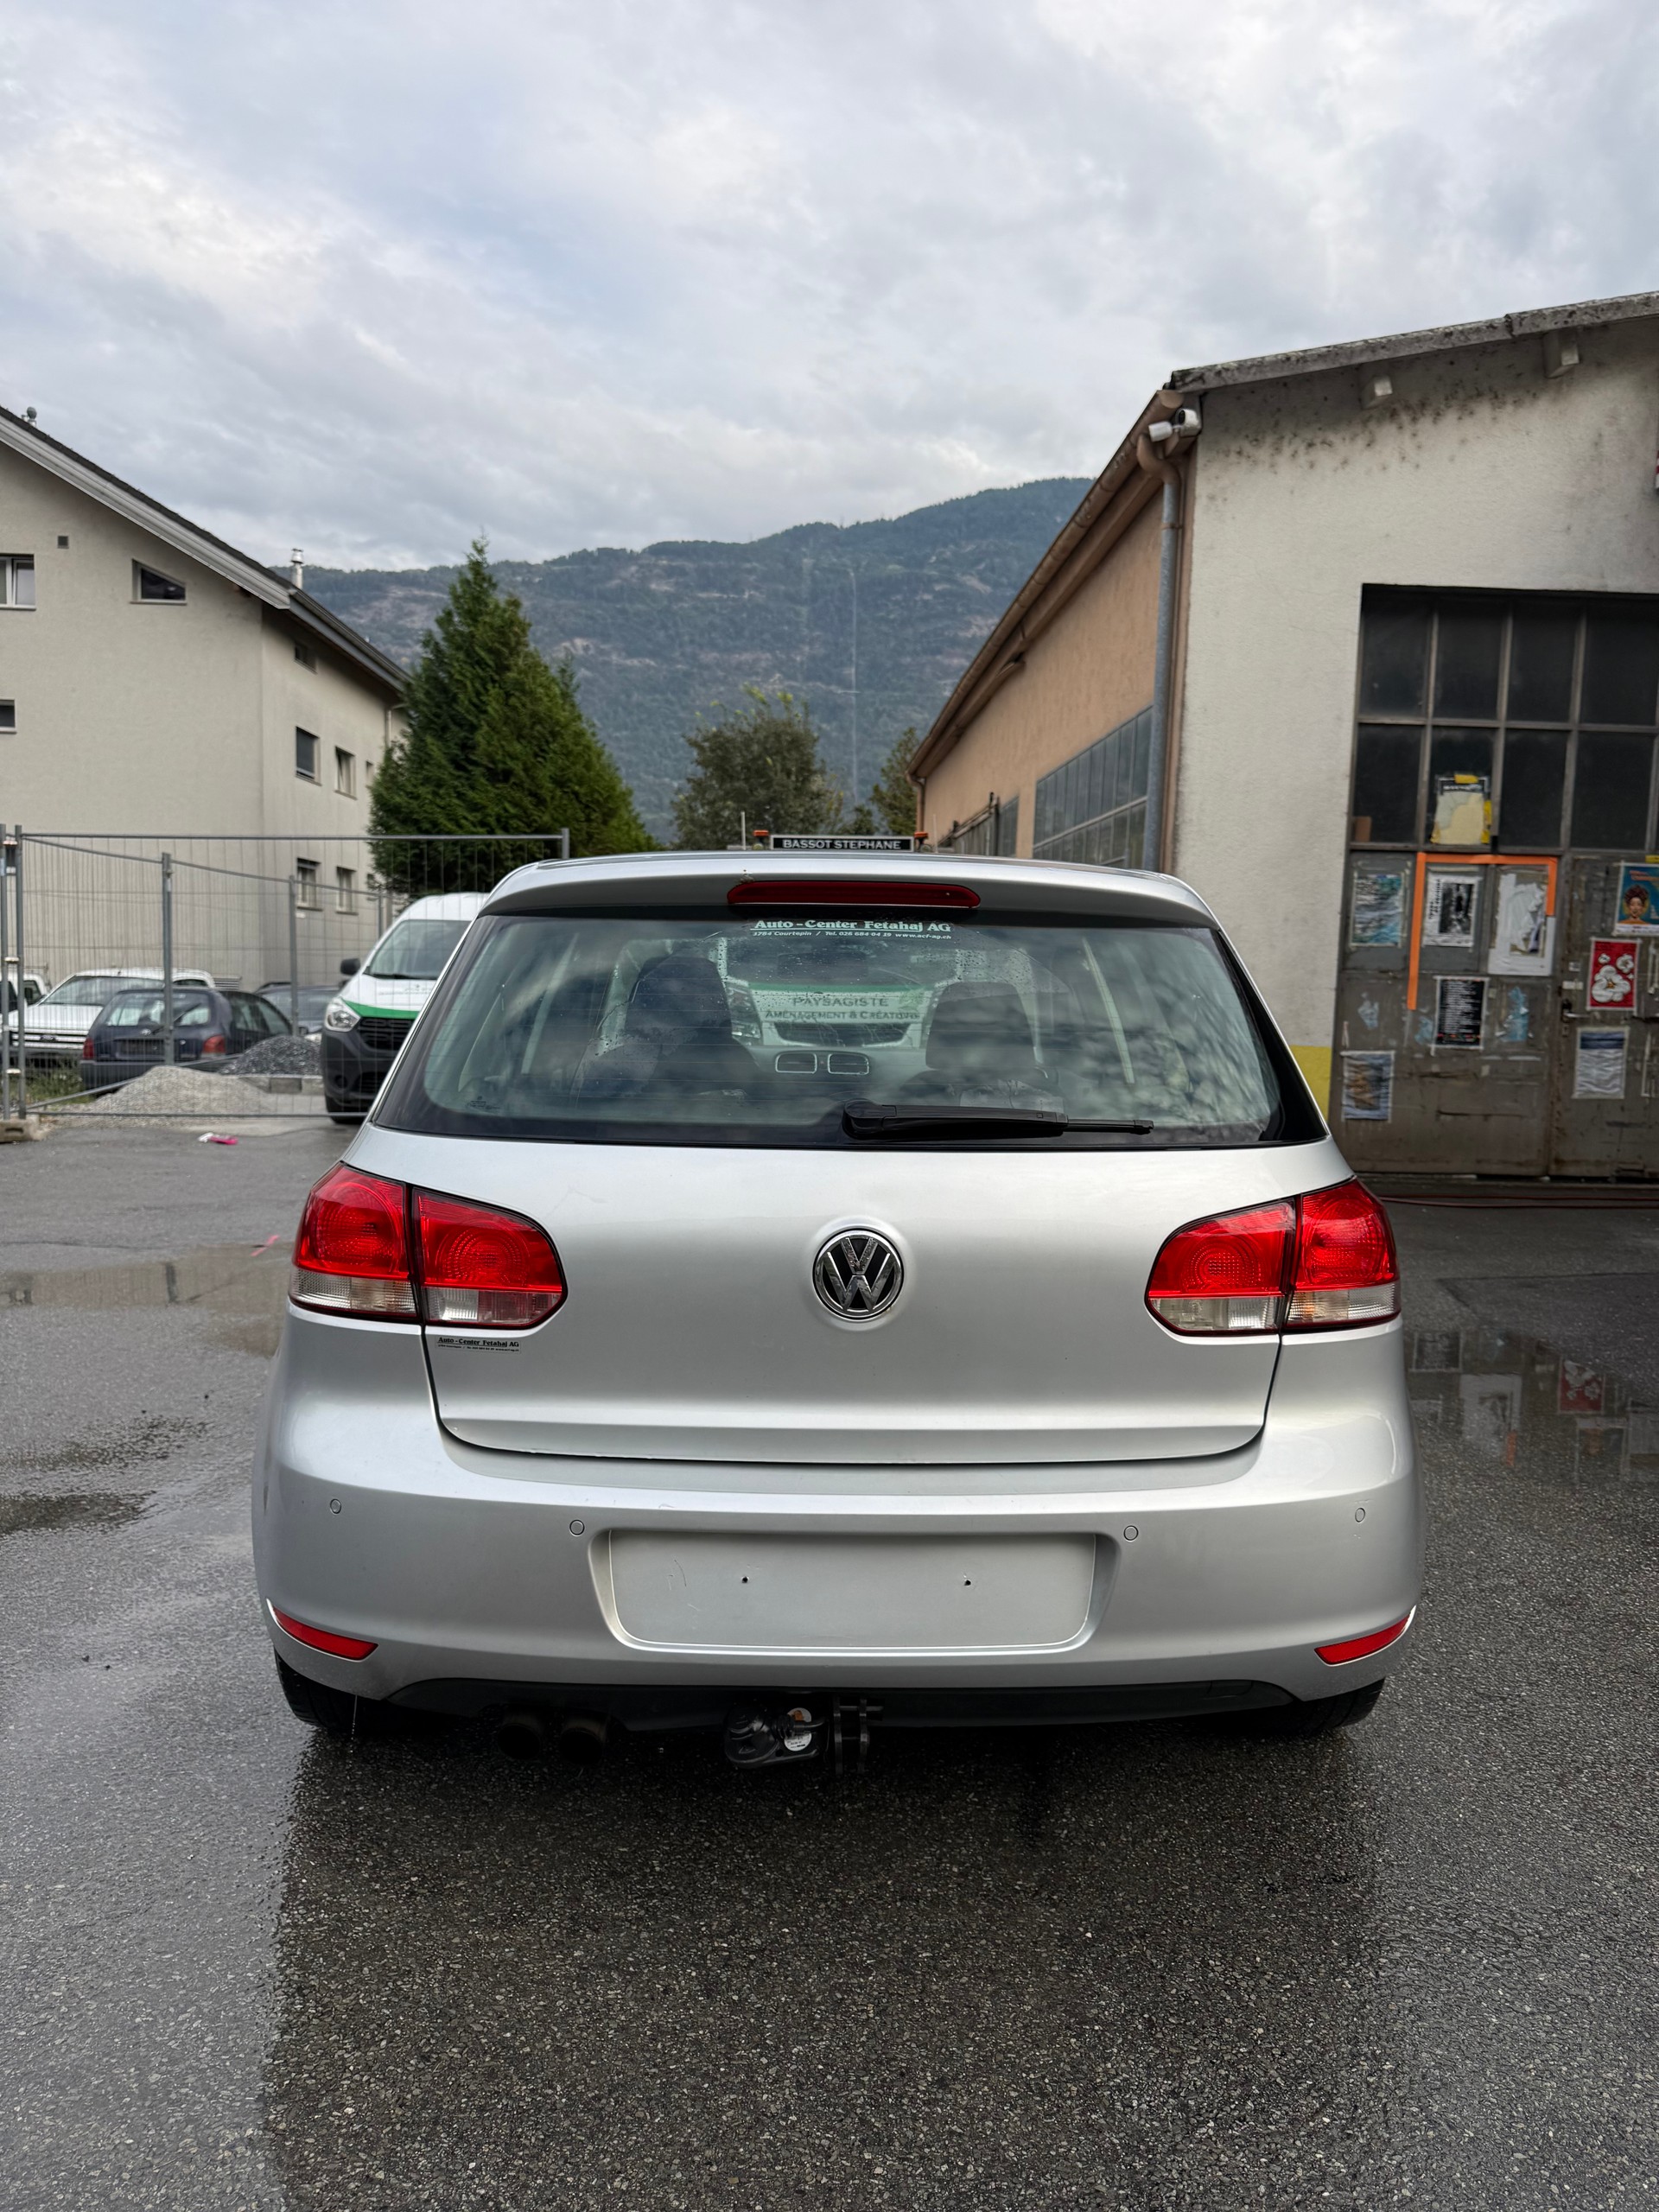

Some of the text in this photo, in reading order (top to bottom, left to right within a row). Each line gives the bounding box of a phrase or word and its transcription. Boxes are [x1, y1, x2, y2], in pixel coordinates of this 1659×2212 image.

[782, 839, 901, 850] BASSOT STEPHANE
[754, 919, 794, 929] Auto
[804, 919, 858, 929] Center
[864, 920, 923, 932] Fetahaj
[927, 923, 950, 932] AG
[793, 997, 889, 1007] PAYSAGISTE
